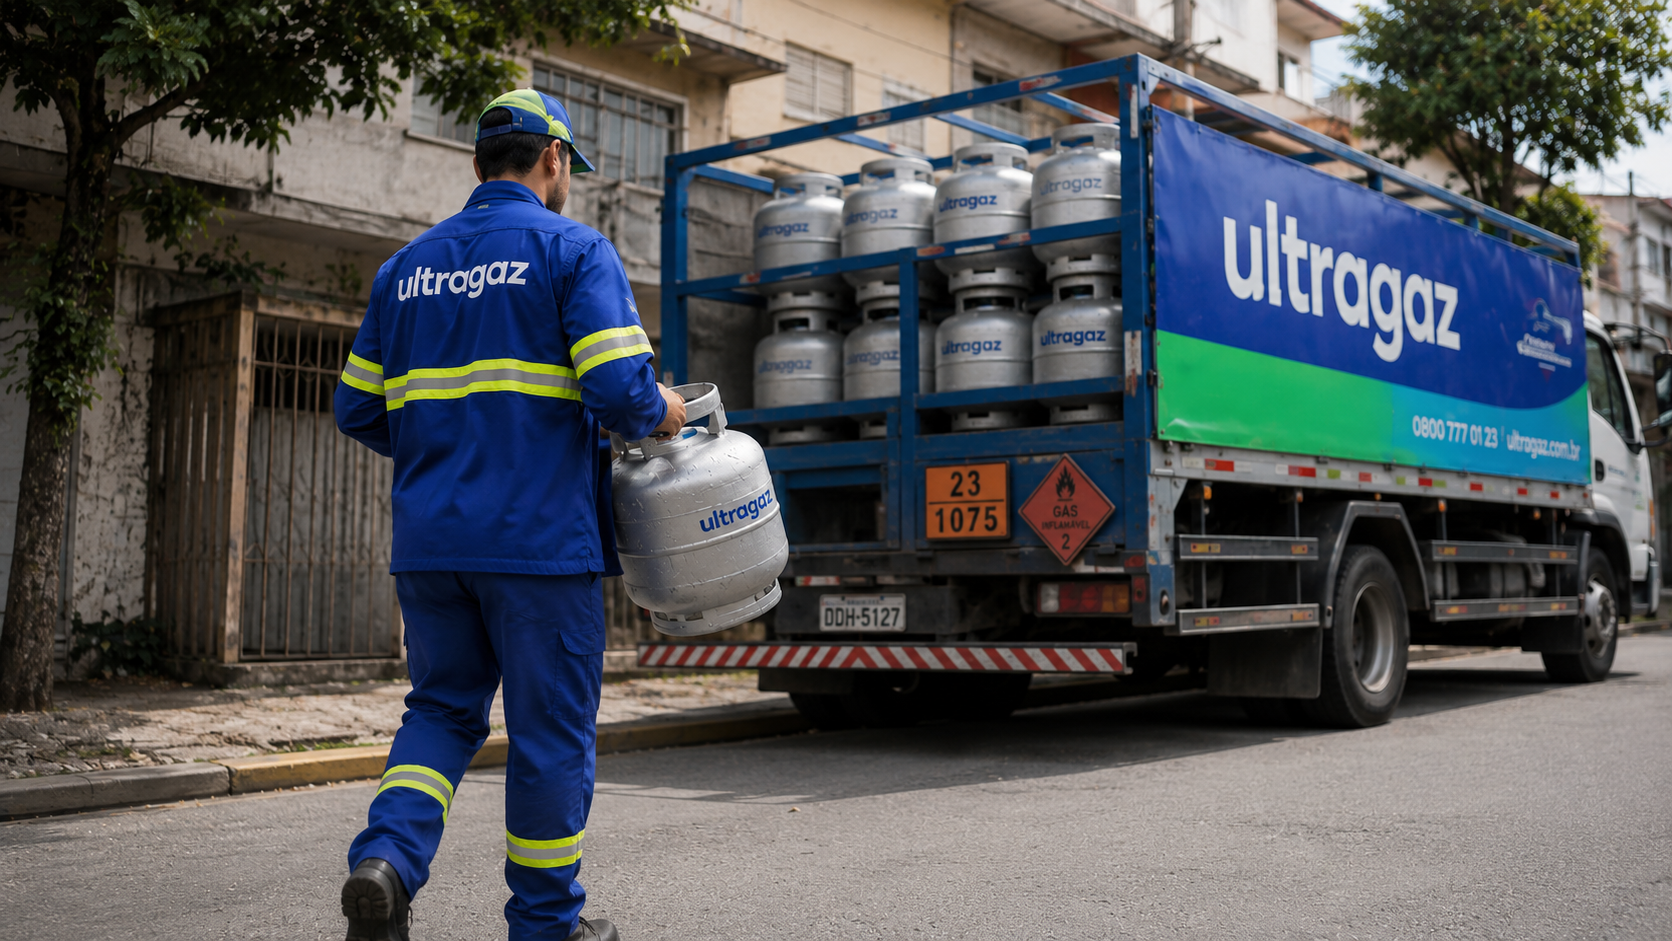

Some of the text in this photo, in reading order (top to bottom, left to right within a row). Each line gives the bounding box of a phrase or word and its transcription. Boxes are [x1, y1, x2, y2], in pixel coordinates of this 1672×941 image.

[397, 261, 530, 301] ultragaz
[1223, 199, 1461, 363] ultragaz
[1040, 330, 1106, 346] ultragaz
[1412, 415, 1445, 441] 0800
[1447, 421, 1468, 444] 777
[950, 470, 981, 497] 23
[699, 489, 773, 532] ultragaz
[935, 506, 998, 533] 1075
[1061, 533, 1070, 550] 2
